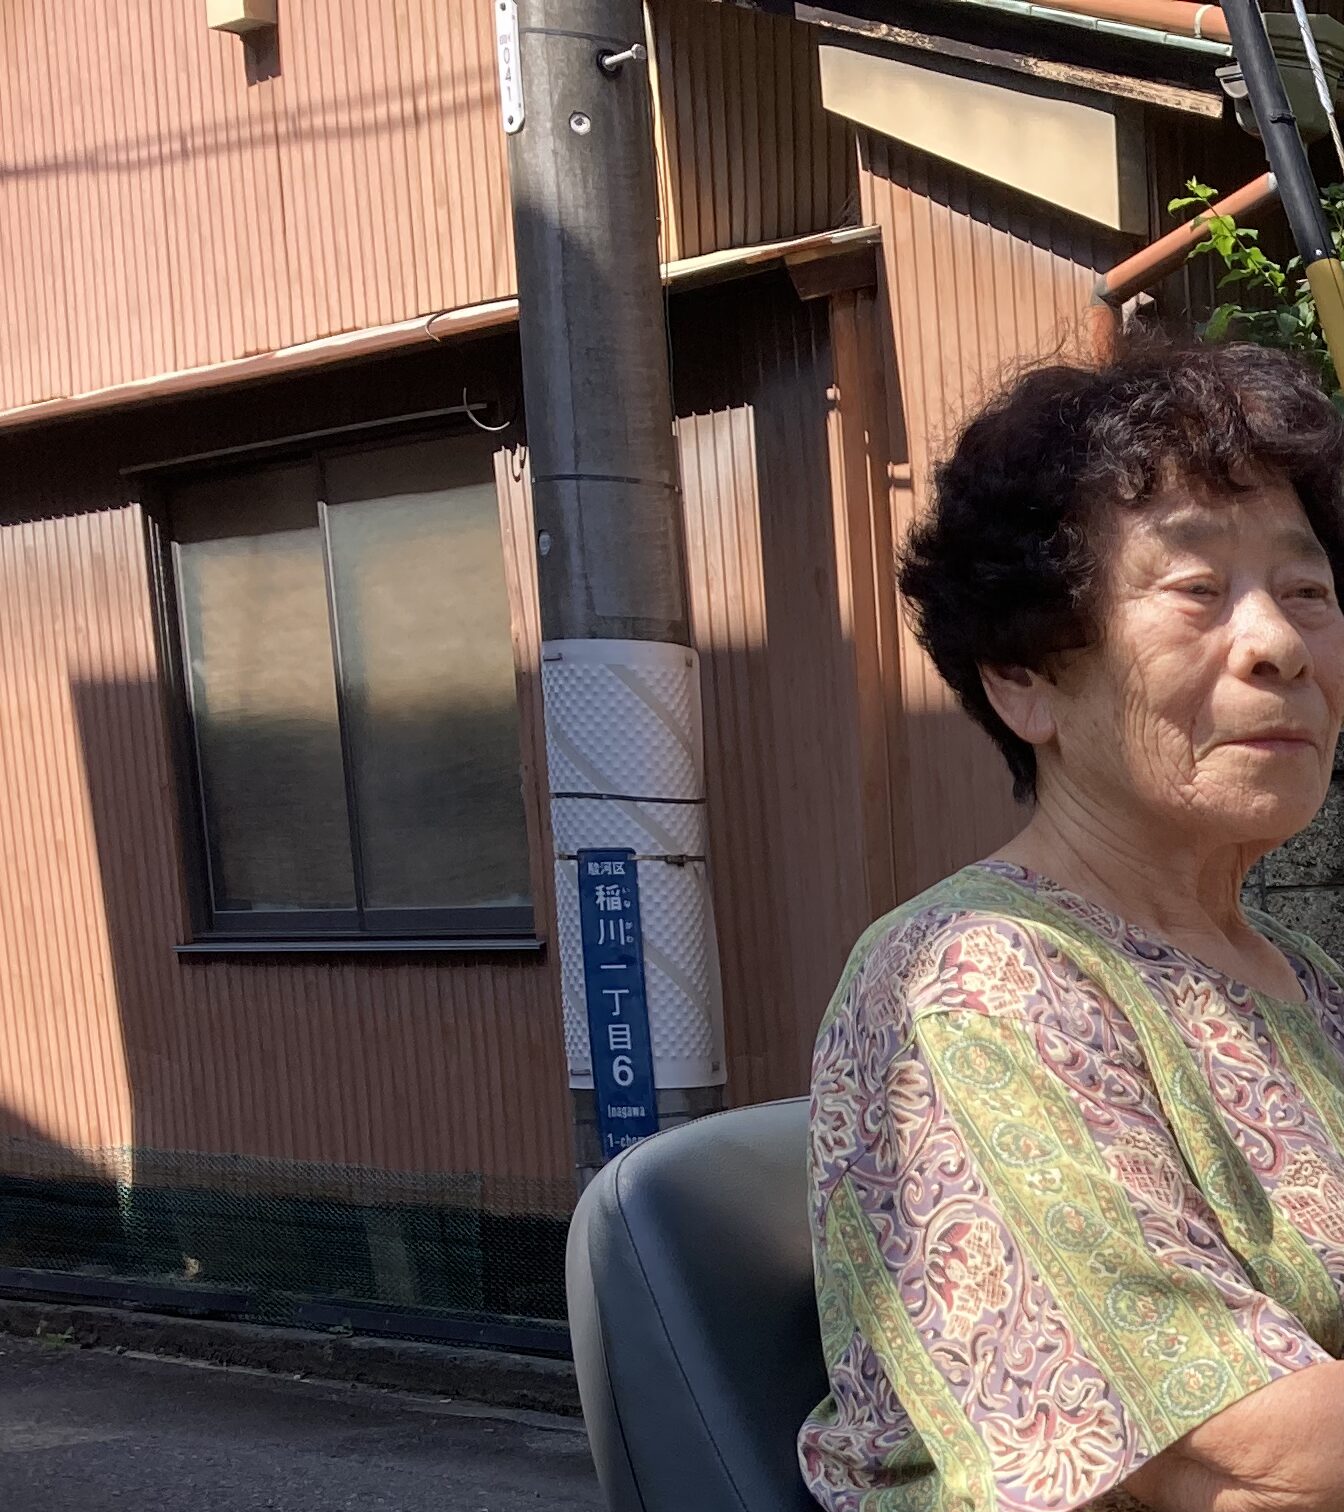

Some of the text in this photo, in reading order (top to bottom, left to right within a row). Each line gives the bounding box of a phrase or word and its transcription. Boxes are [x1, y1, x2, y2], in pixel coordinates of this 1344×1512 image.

[587, 861, 626, 876] 駿河区
[607, 1104, 646, 1119] Inagawa
[607, 1133, 645, 1148] 1-cho
